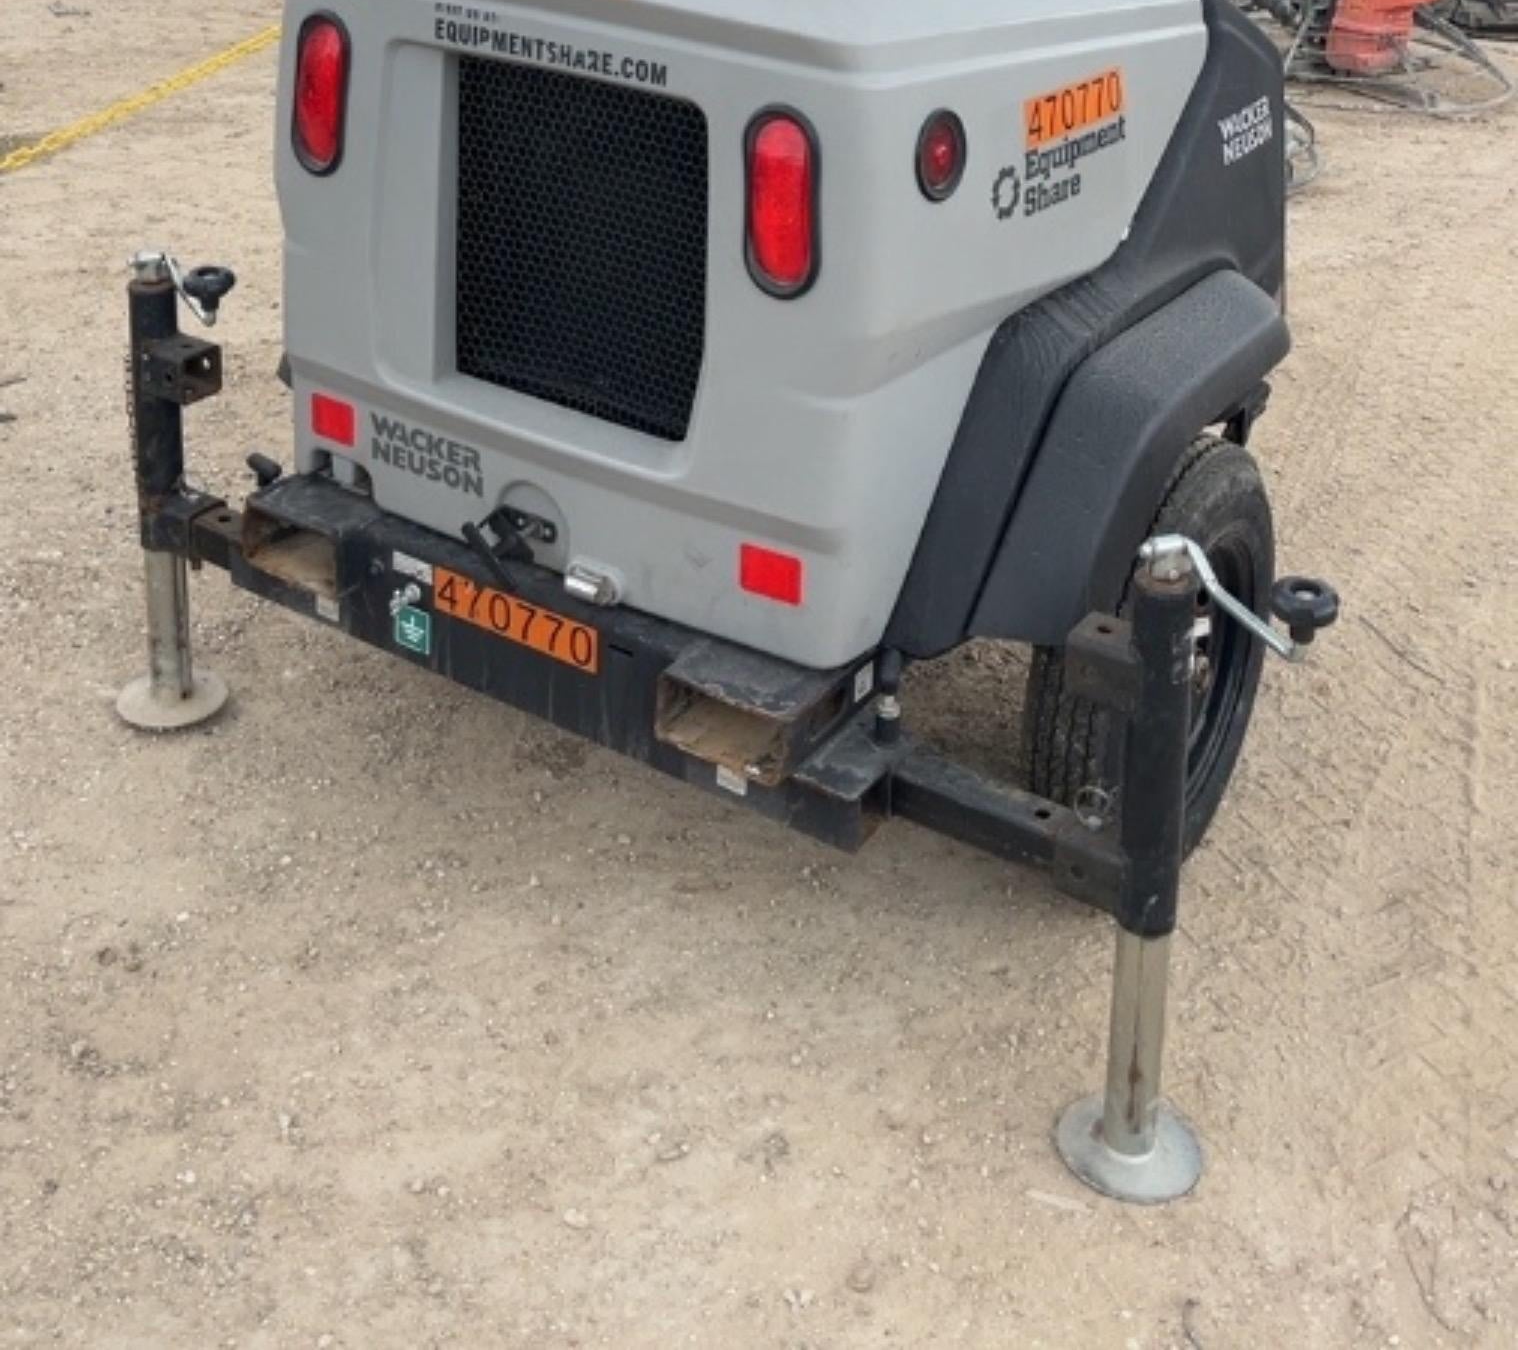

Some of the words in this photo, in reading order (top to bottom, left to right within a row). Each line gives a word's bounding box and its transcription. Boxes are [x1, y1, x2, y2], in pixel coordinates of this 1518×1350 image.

[434, 17, 667, 87] EQUIPMENTSHARE.COM
[1028, 71, 1121, 141] 470770
[1025, 115, 1125, 180] Equipment
[1024, 173, 1081, 217] Share
[371, 412, 481, 473] WACKER
[371, 437, 484, 498] NEUSON
[437, 576, 592, 666] 470770
